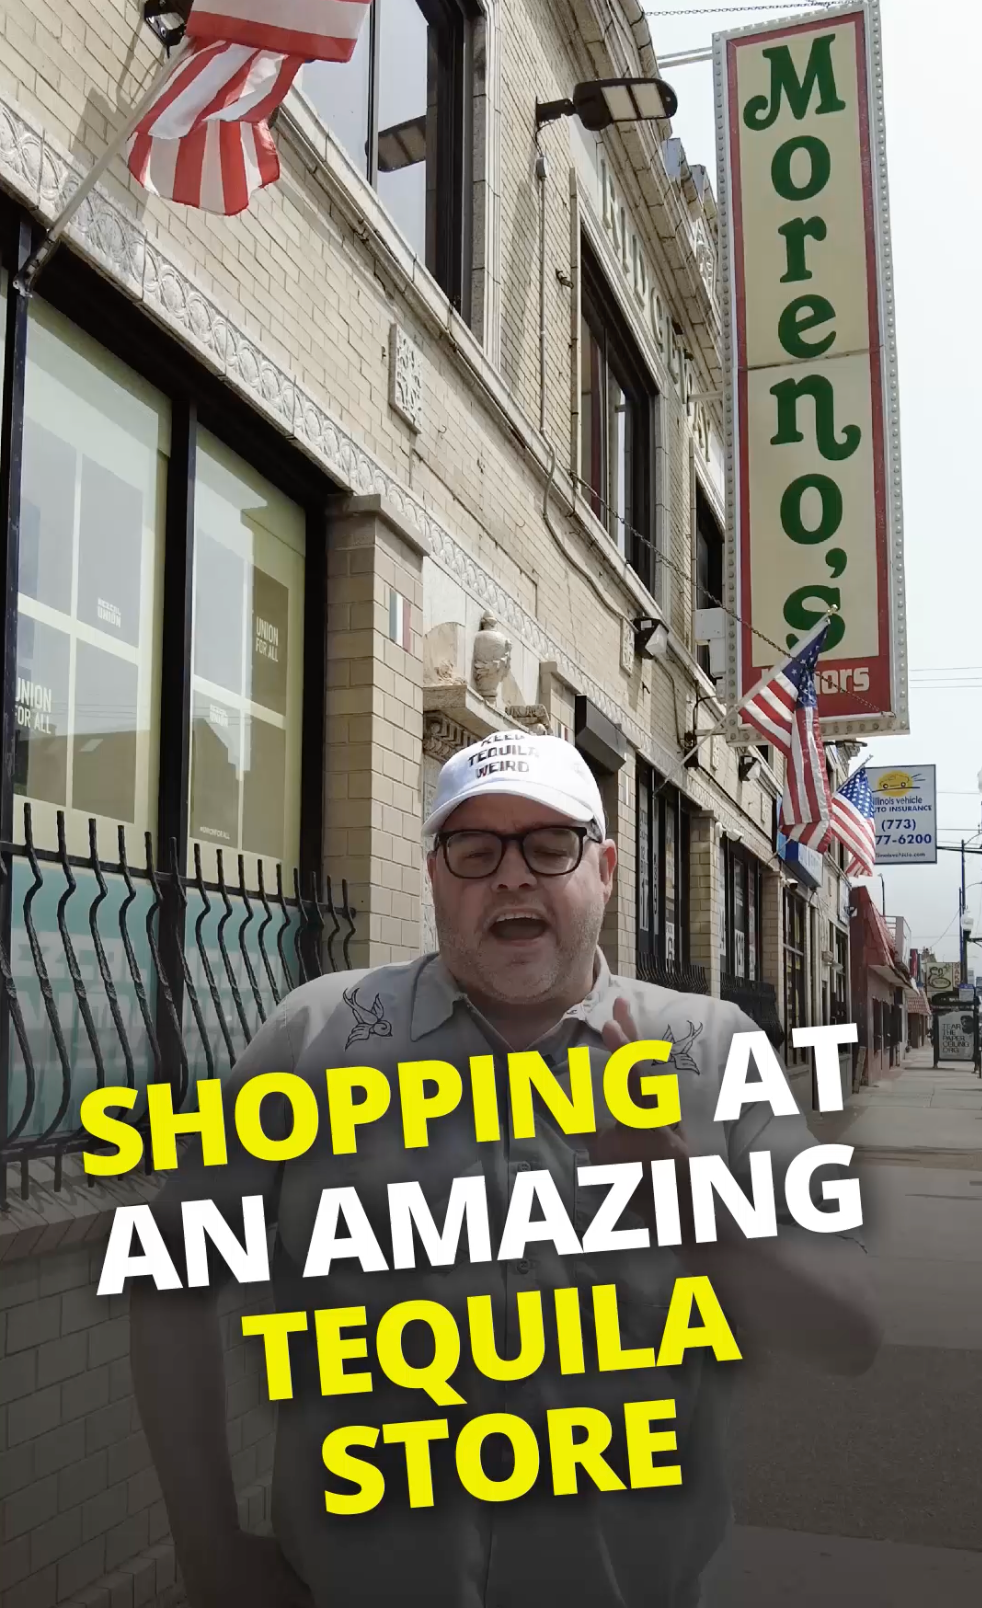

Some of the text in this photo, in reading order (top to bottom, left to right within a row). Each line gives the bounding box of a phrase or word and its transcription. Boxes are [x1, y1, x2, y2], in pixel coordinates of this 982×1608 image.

[743, 33, 861, 654] Moreno's
[256, 616, 279, 647] UNION
[255, 637, 279, 662] FOR ALL
[34, 712, 52, 734] ALL
[468, 744, 540, 768] TEQUILA
[476, 760, 530, 779] WEIRD
[896, 795, 923, 804] vehicle
[881, 818, 917, 832] (773)
[875, 833, 932, 846] 77-6200
